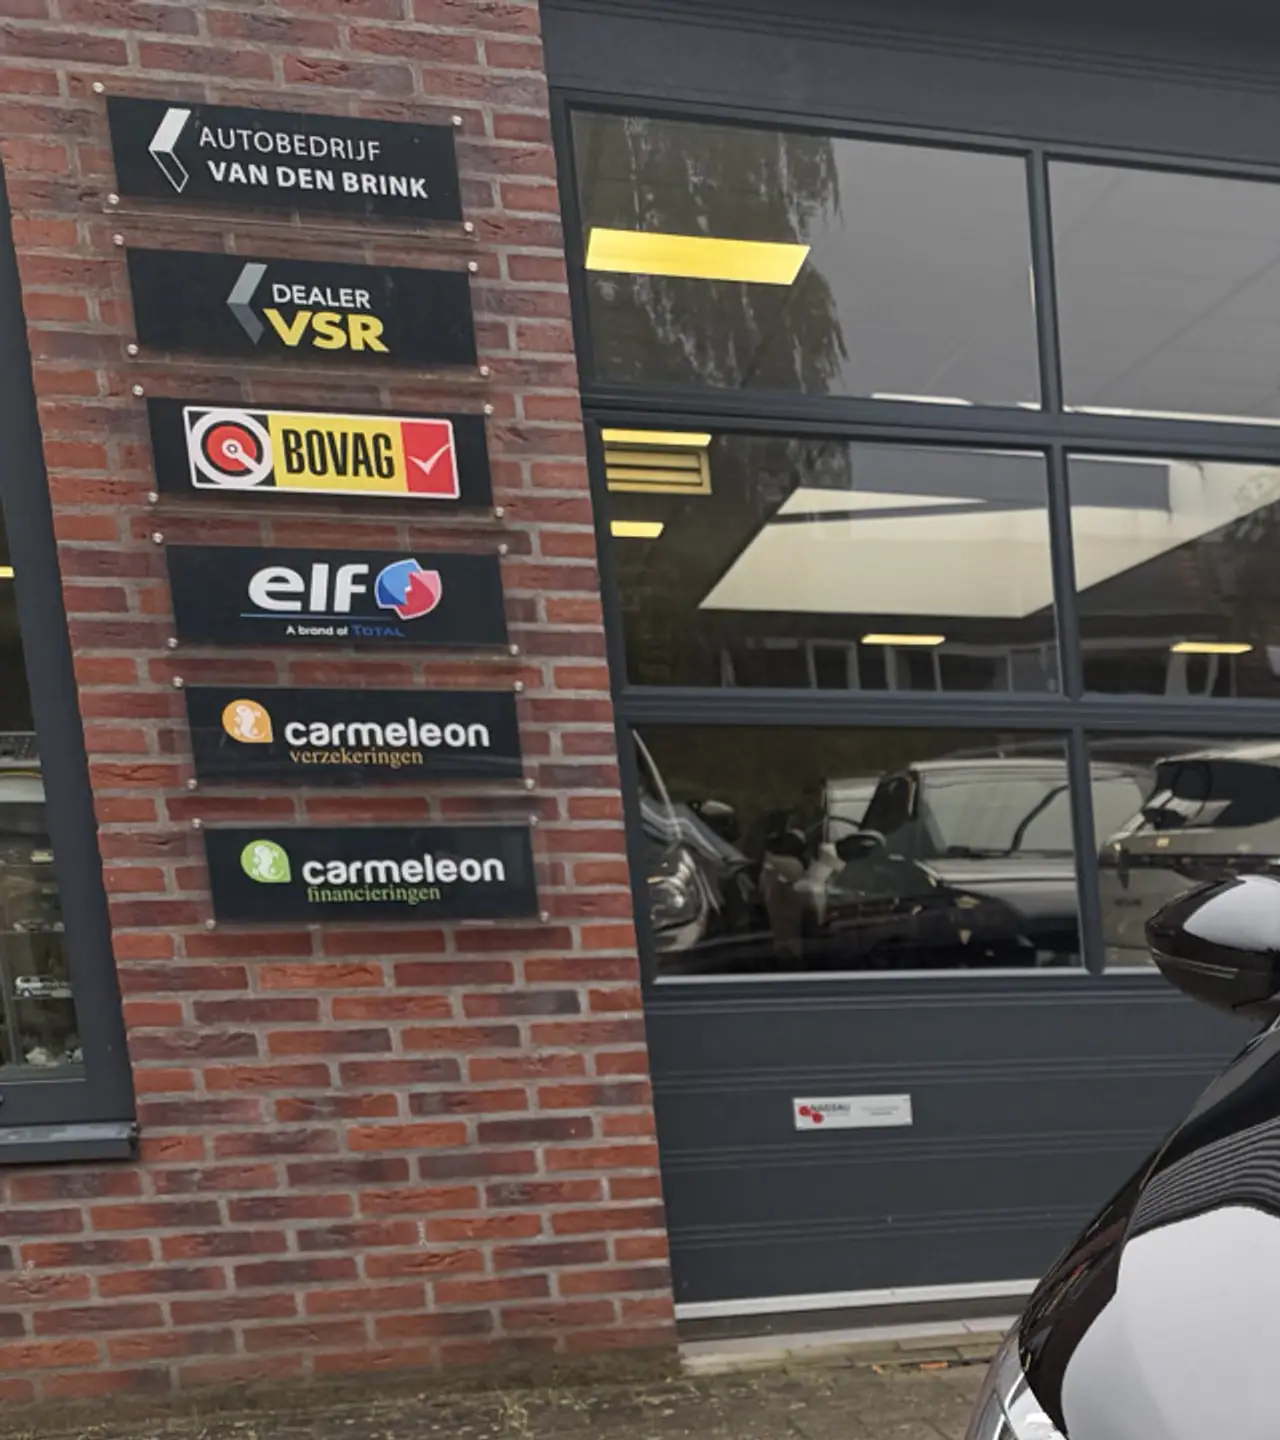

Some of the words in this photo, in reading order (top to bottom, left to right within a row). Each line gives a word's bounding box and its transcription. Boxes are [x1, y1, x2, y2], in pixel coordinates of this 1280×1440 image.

[199, 126, 381, 161] AUTOBEDRIJF
[207, 160, 269, 185] VAN
[276, 166, 336, 191] DEN
[342, 172, 429, 199] BRINK
[272, 283, 371, 309] DEALER
[263, 308, 390, 353] VSR
[281, 428, 396, 480] BOVAG
[248, 563, 370, 612] elf
[286, 625, 296, 636] A
[298, 625, 334, 636] brand
[284, 718, 490, 748] carmeleon
[289, 749, 424, 769] verzekeringen
[302, 854, 506, 886] carmeleon
[307, 886, 441, 905] financieringen
